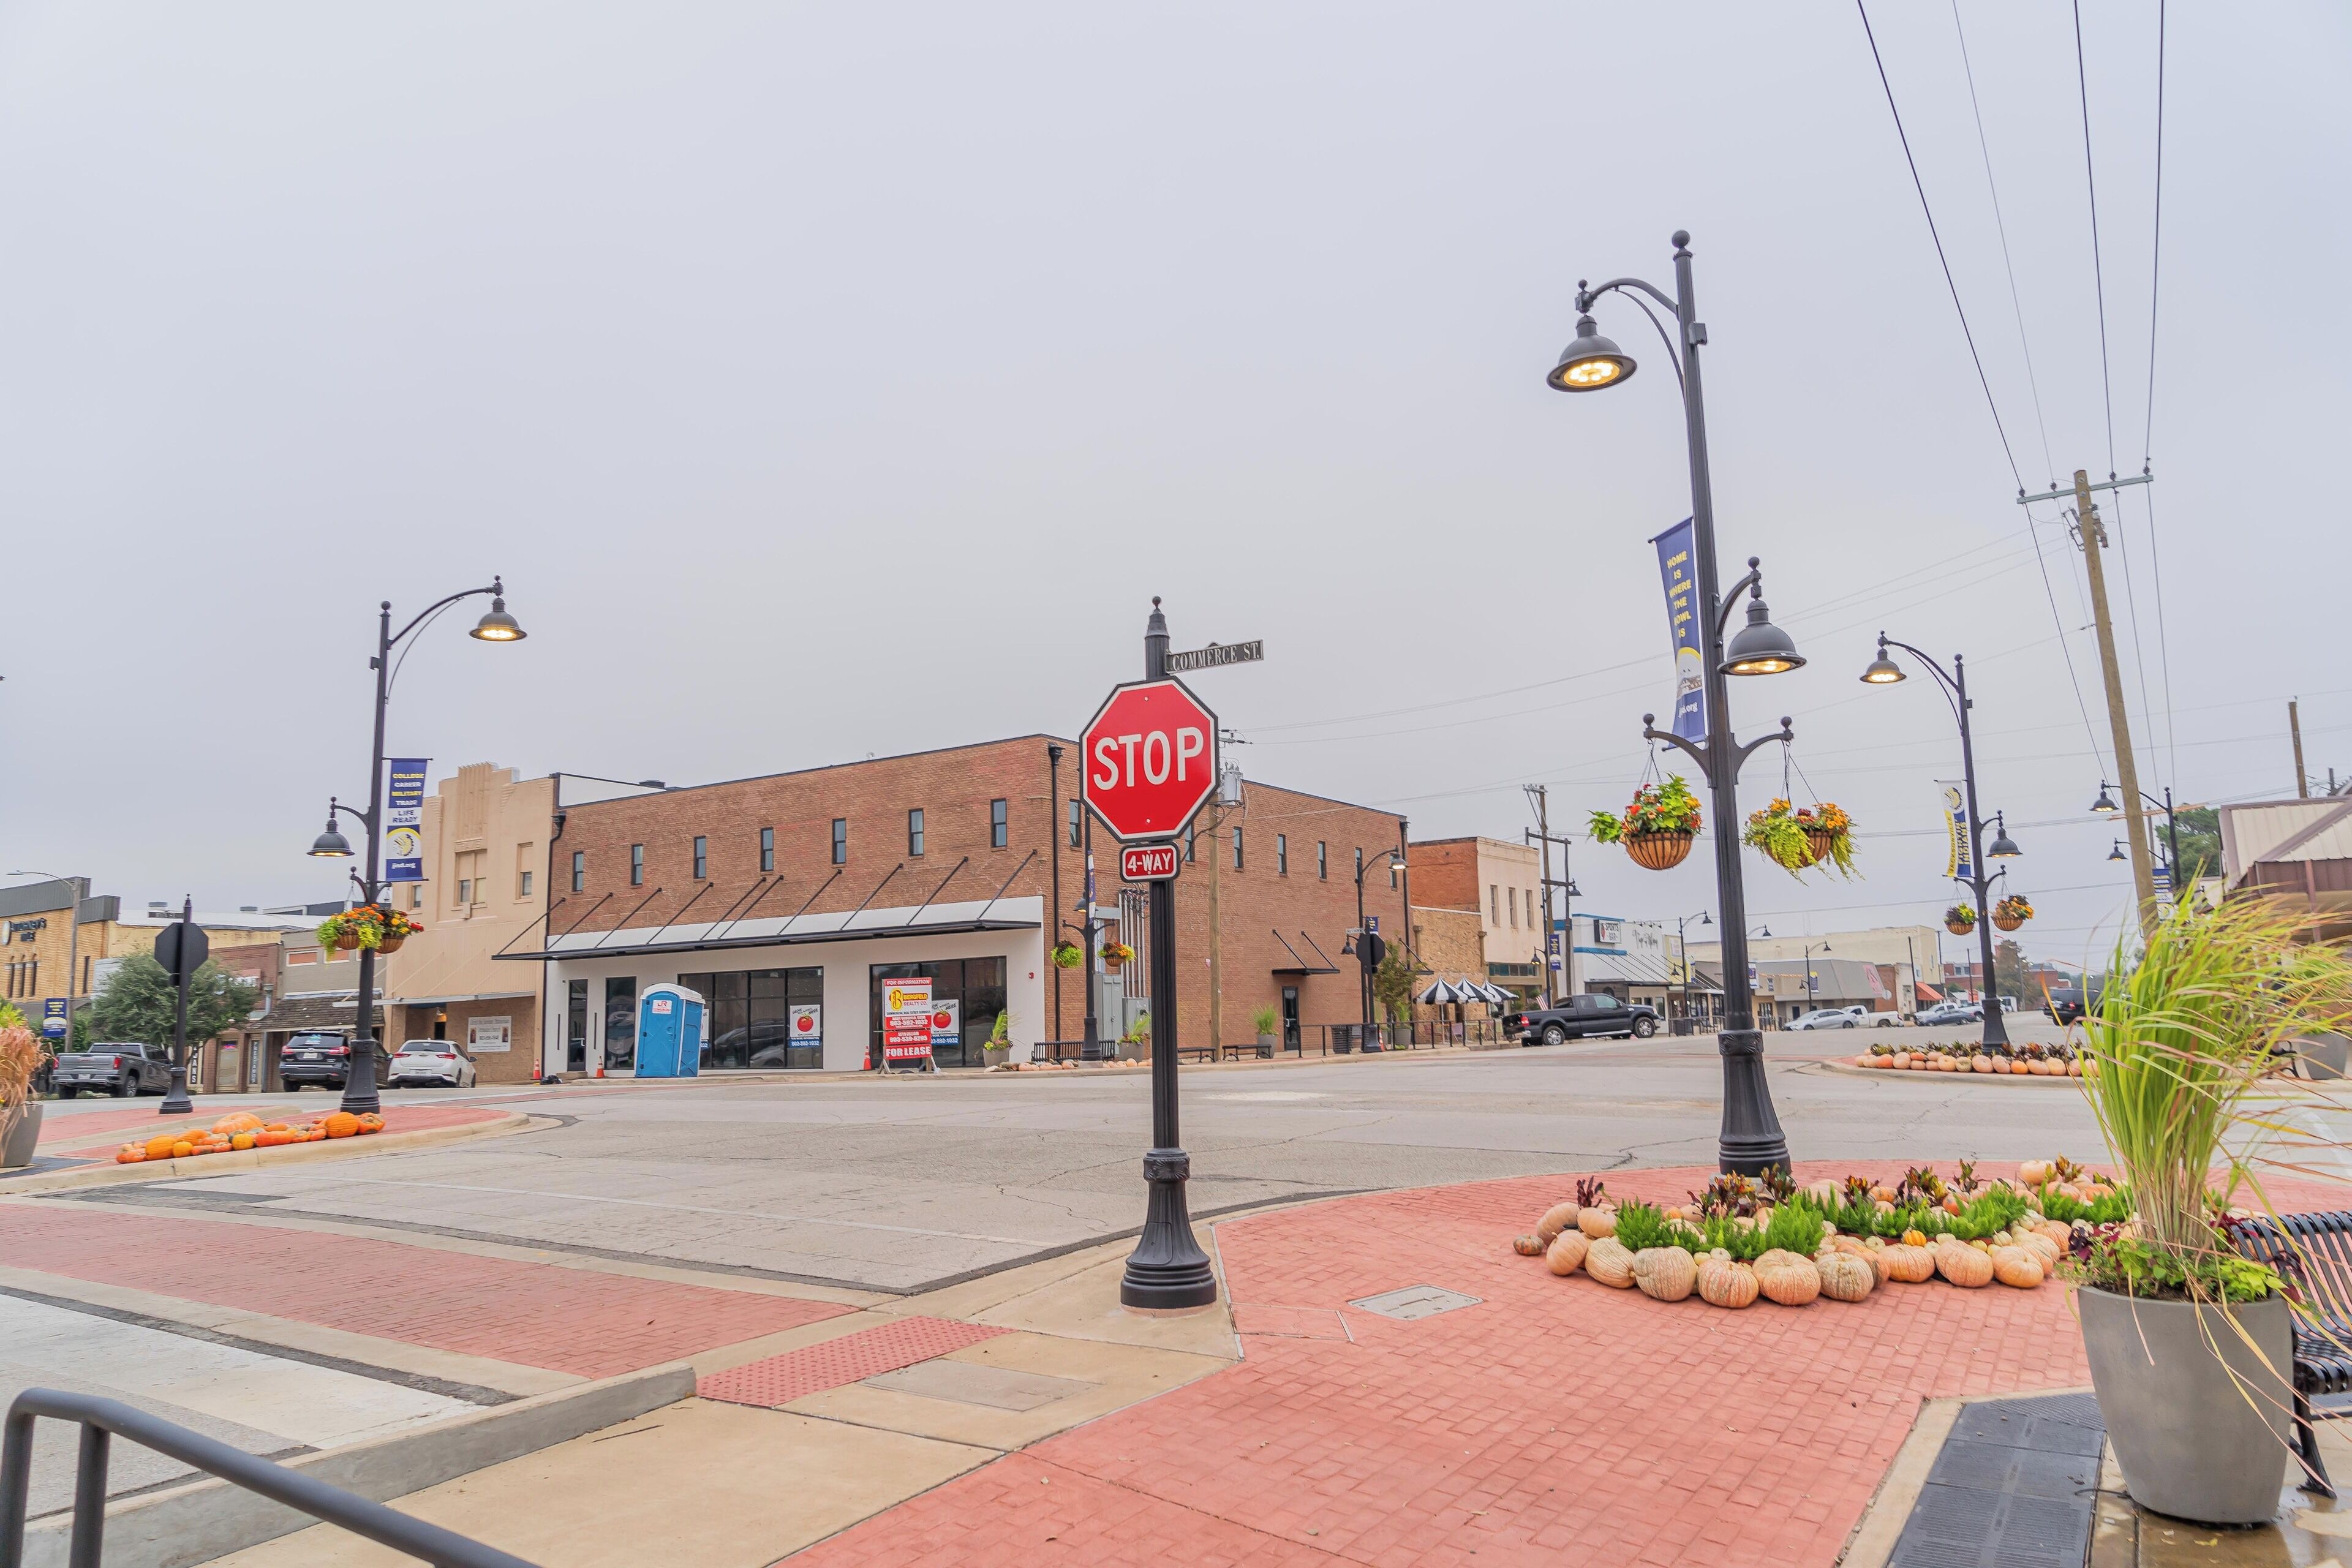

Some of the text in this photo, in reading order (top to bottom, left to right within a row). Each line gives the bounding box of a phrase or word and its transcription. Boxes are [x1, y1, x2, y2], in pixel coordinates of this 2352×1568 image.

[1667, 551, 1687, 569] HOME
[1673, 568, 1682, 580] IS
[1673, 597, 1687, 610] THE
[1678, 628, 1686, 638] IS
[1172, 643, 1260, 671] COMMERCE ST.
[1093, 727, 1204, 790] STOP
[1947, 817, 1956, 872] JACKSONVILLE
[1127, 853, 1172, 872] 4-WAY
[1605, 922, 1619, 931] SPORTS
[886, 1046, 931, 1057] FOR LEASE
